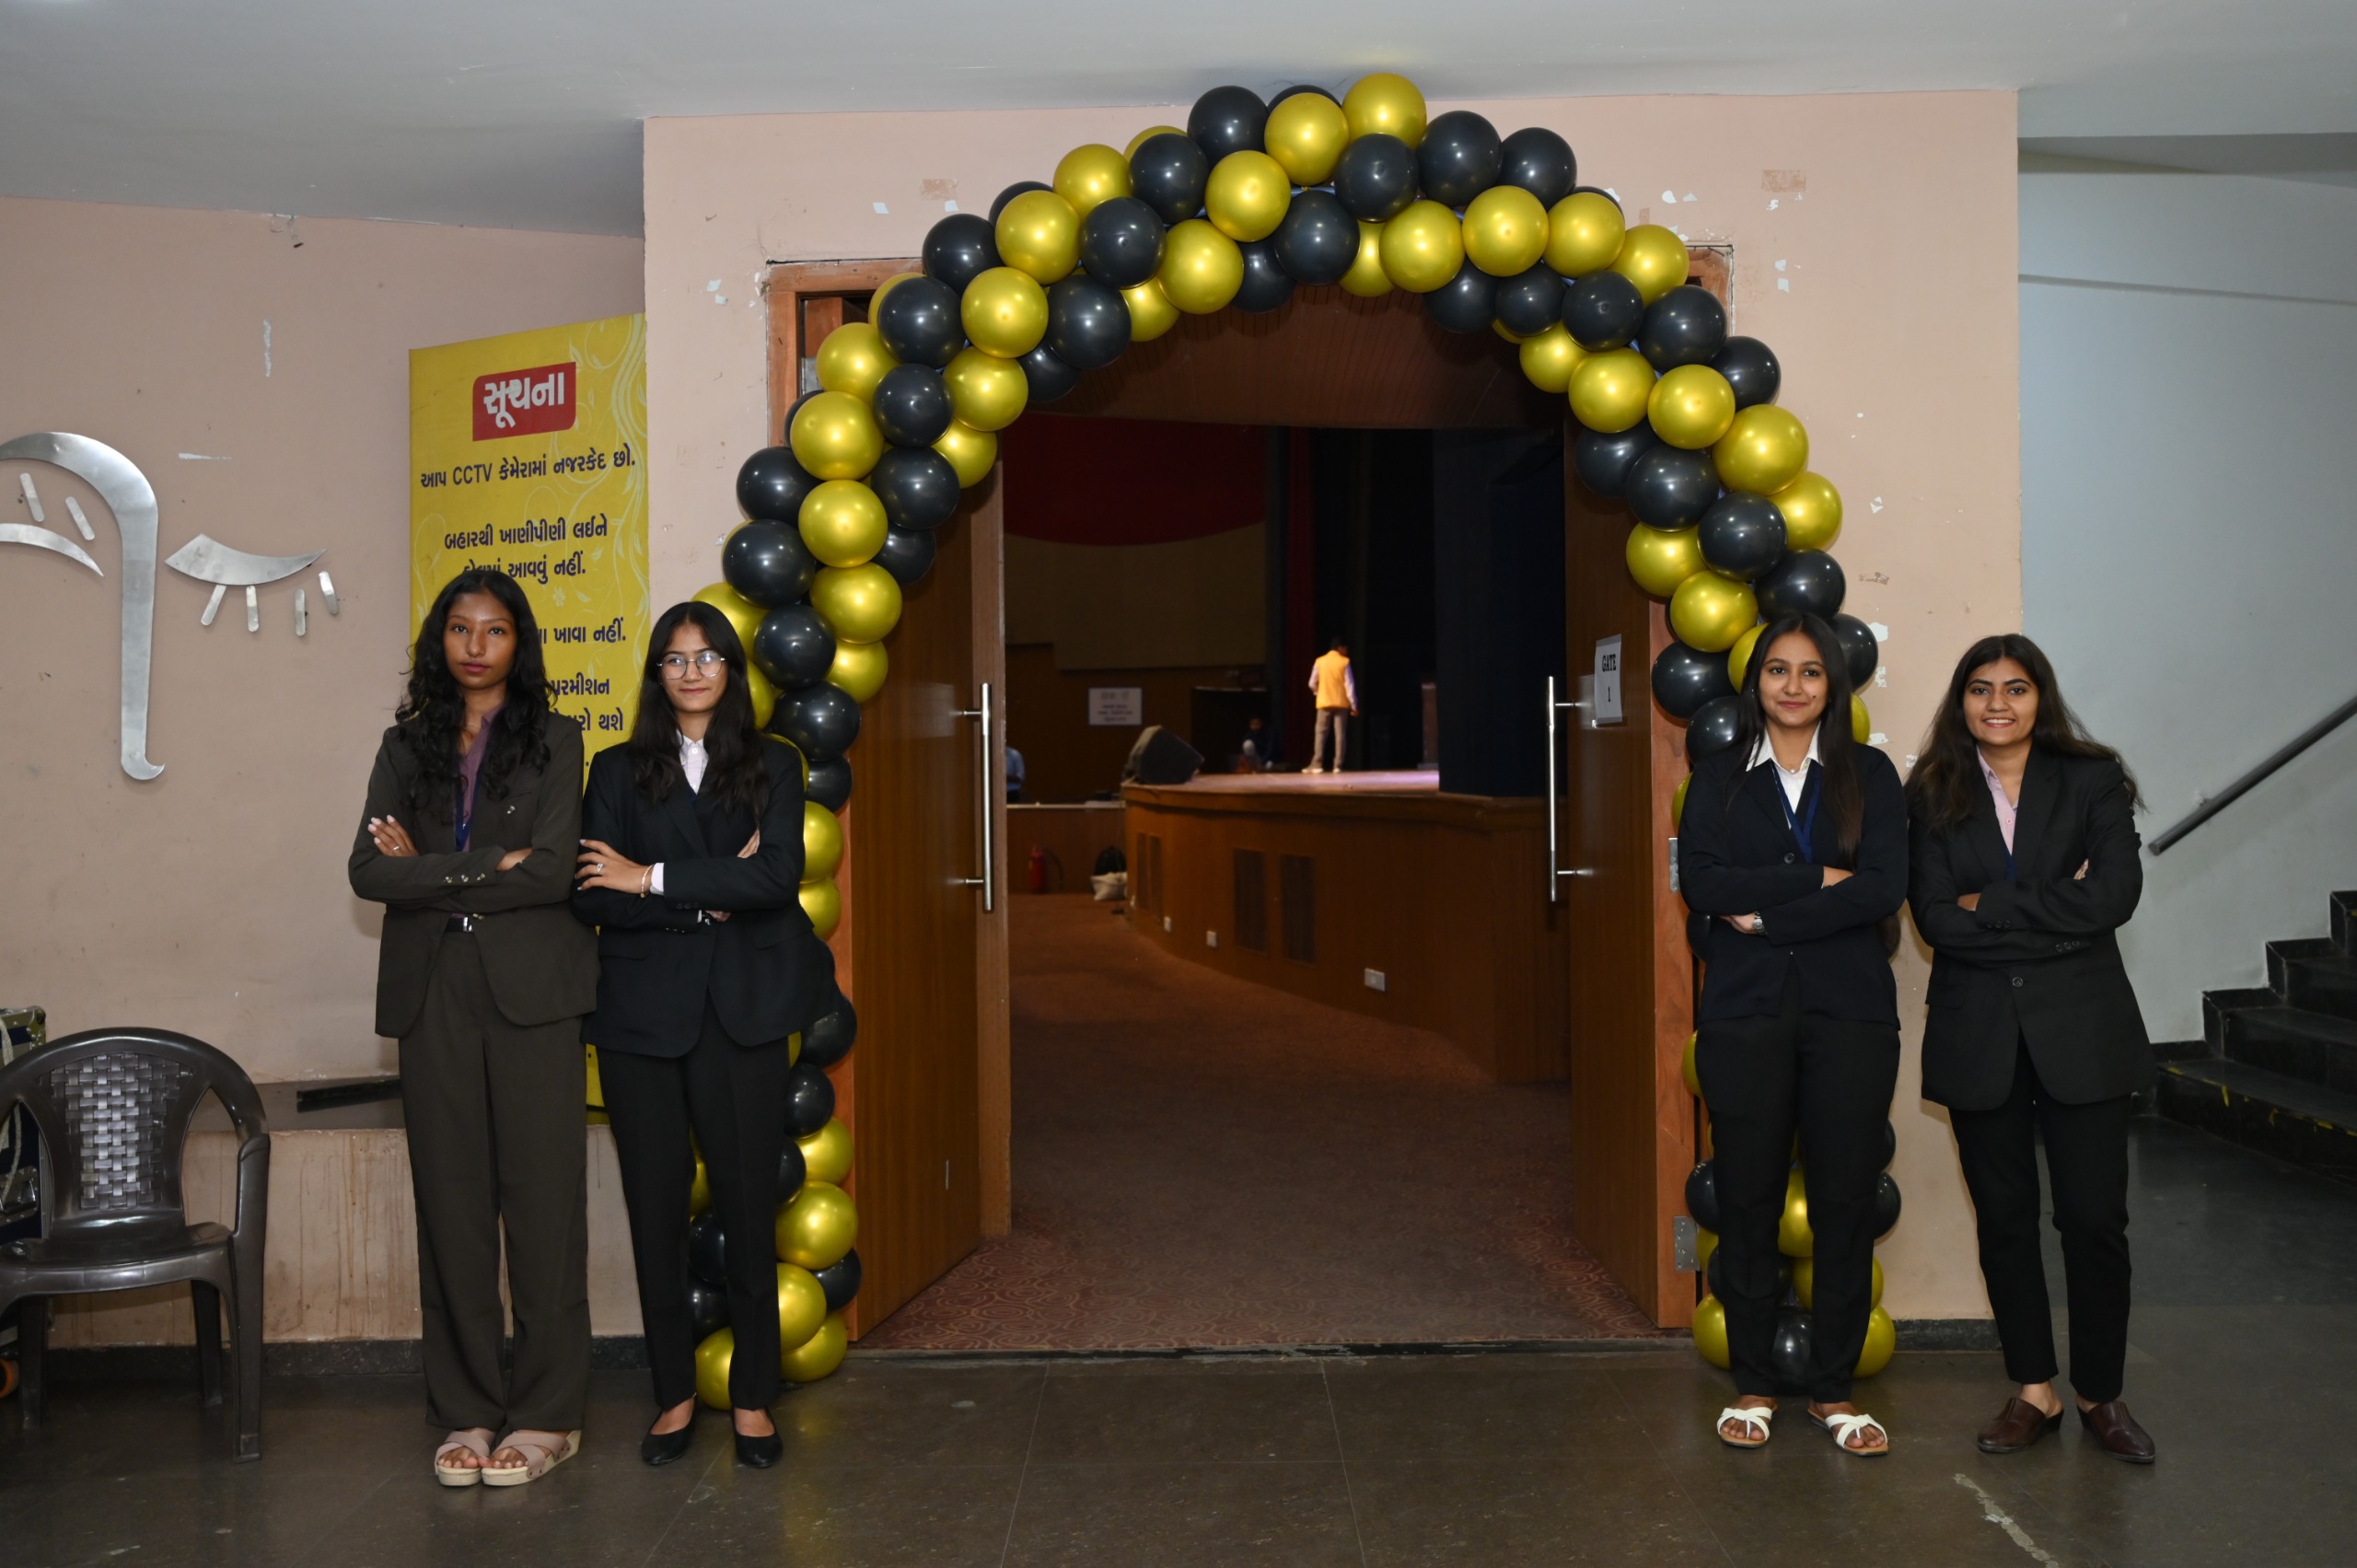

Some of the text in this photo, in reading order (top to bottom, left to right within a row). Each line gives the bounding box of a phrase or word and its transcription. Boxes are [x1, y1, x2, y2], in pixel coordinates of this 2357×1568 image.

[483, 372, 564, 429] સૂચના
[421, 443, 635, 487] આપ CCTV કેમેરામાં નજરકેદ છો.
[445, 513, 608, 549] બહારથી ખાણીપીણી લઈને
[508, 554, 549, 584] આવવું
[554, 551, 586, 575] નહીં.
[553, 627, 586, 644] ખાવા
[594, 617, 626, 643] નહીં.
[1602, 654, 1616, 672] GATE
[1608, 686, 1611, 703] 1
[598, 707, 623, 730] થશે
